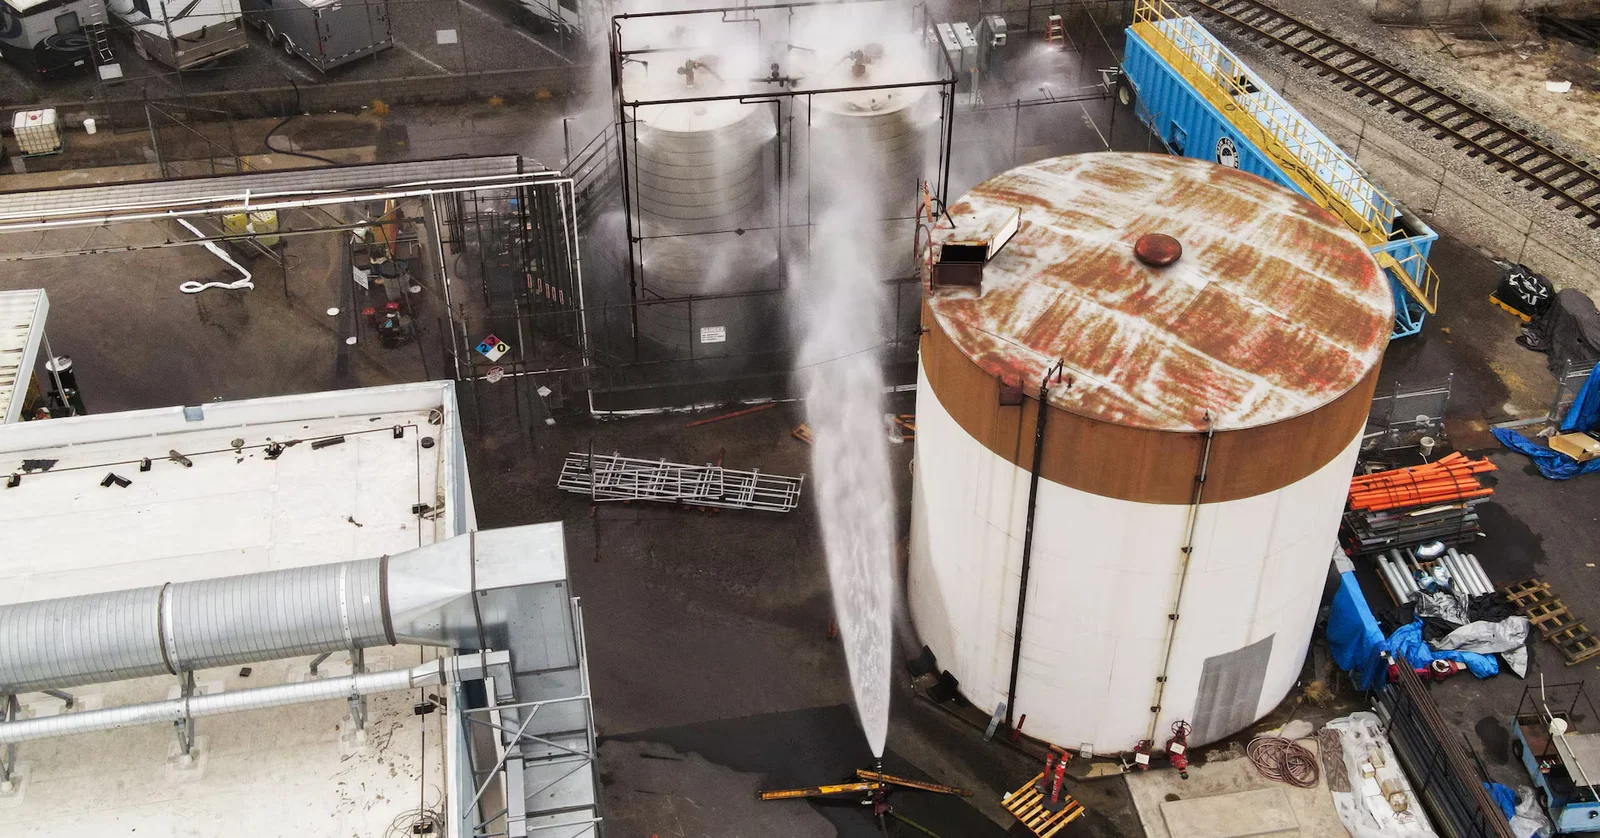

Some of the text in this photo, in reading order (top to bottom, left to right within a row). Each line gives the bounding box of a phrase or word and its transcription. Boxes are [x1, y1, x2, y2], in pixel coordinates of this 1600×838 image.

[489, 337, 495, 345] 3
[480, 344, 488, 352] 2
[497, 344, 505, 352] 0
